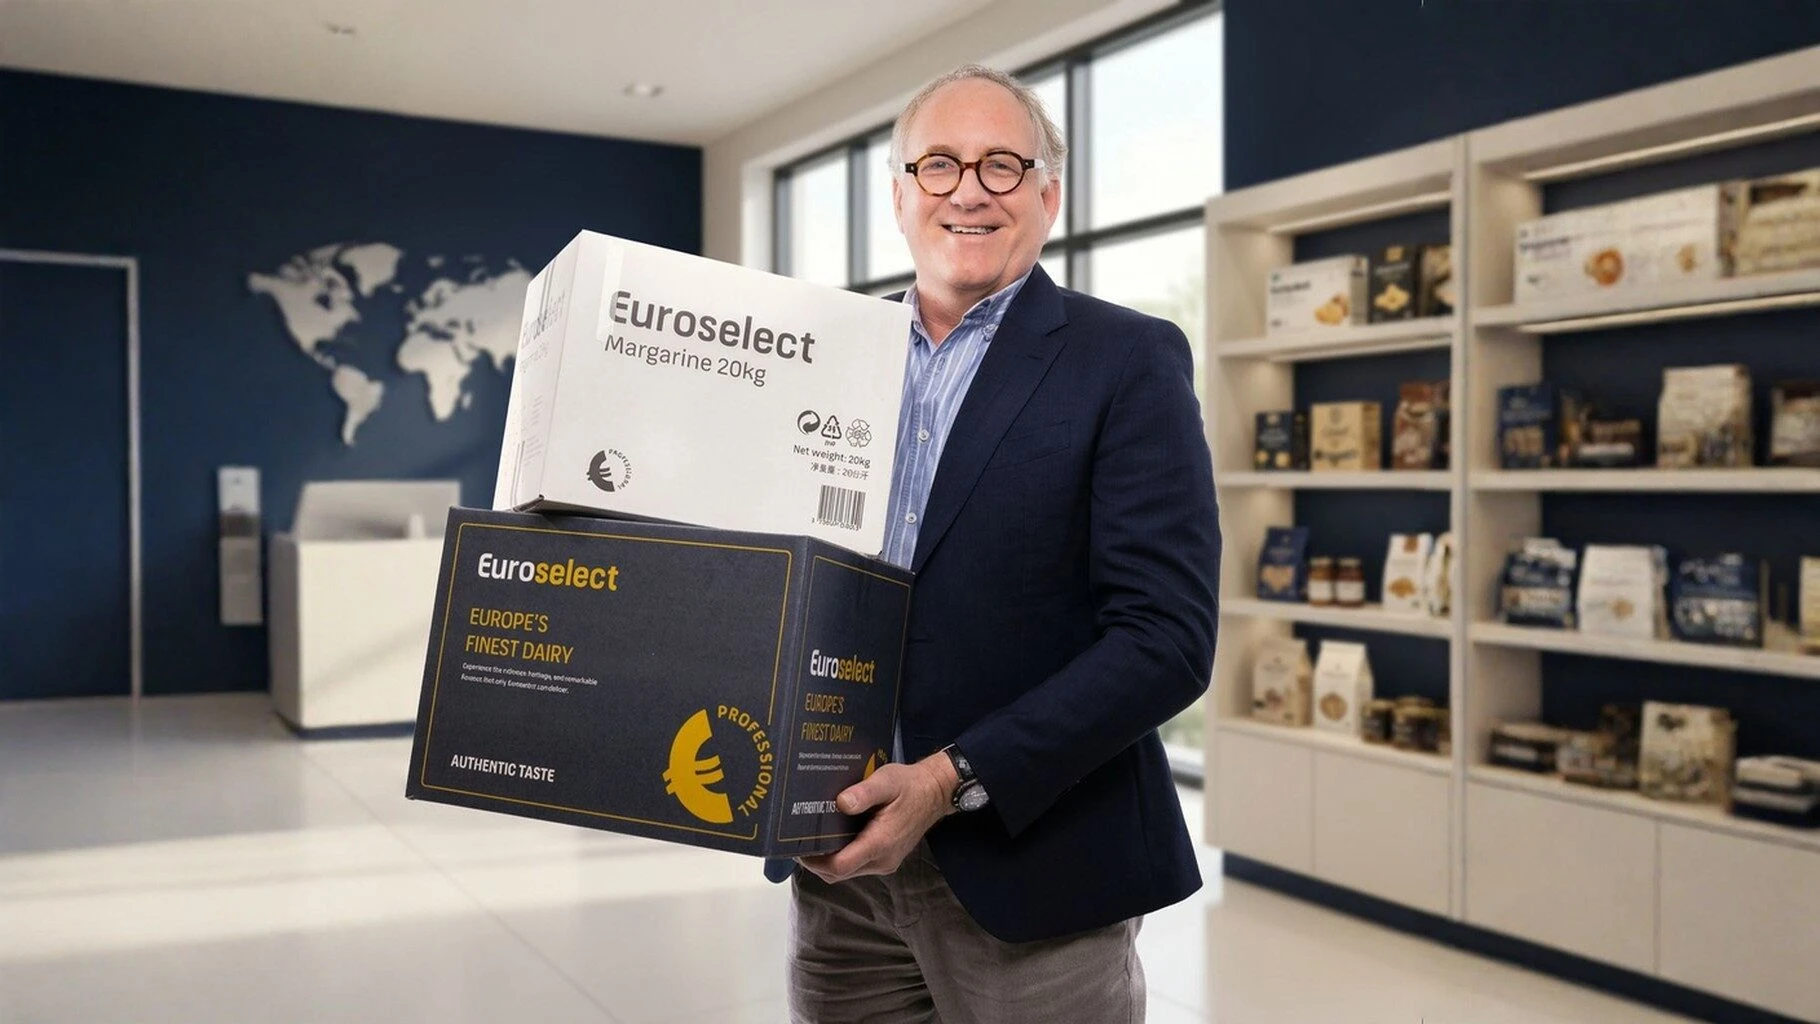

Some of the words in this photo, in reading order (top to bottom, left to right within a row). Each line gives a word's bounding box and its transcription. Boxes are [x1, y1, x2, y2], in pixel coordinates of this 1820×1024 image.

[609, 290, 815, 364] Euroselect
[604, 334, 712, 366] Margarine
[717, 357, 766, 388] 20kg
[793, 444, 809, 456] Net
[811, 448, 847, 463] weight:
[848, 454, 871, 469] 20kg
[477, 552, 619, 592] Euroselect
[469, 607, 549, 633] EUROPE'S
[465, 635, 520, 658] FINEST
[522, 641, 574, 664] DAIRY
[810, 649, 876, 684] Euroselect
[801, 722, 830, 741] FINEST
[450, 754, 517, 777] AUTHENTIC
[518, 764, 555, 782] TASTE
[717, 704, 773, 817] PROFESSIONAL
